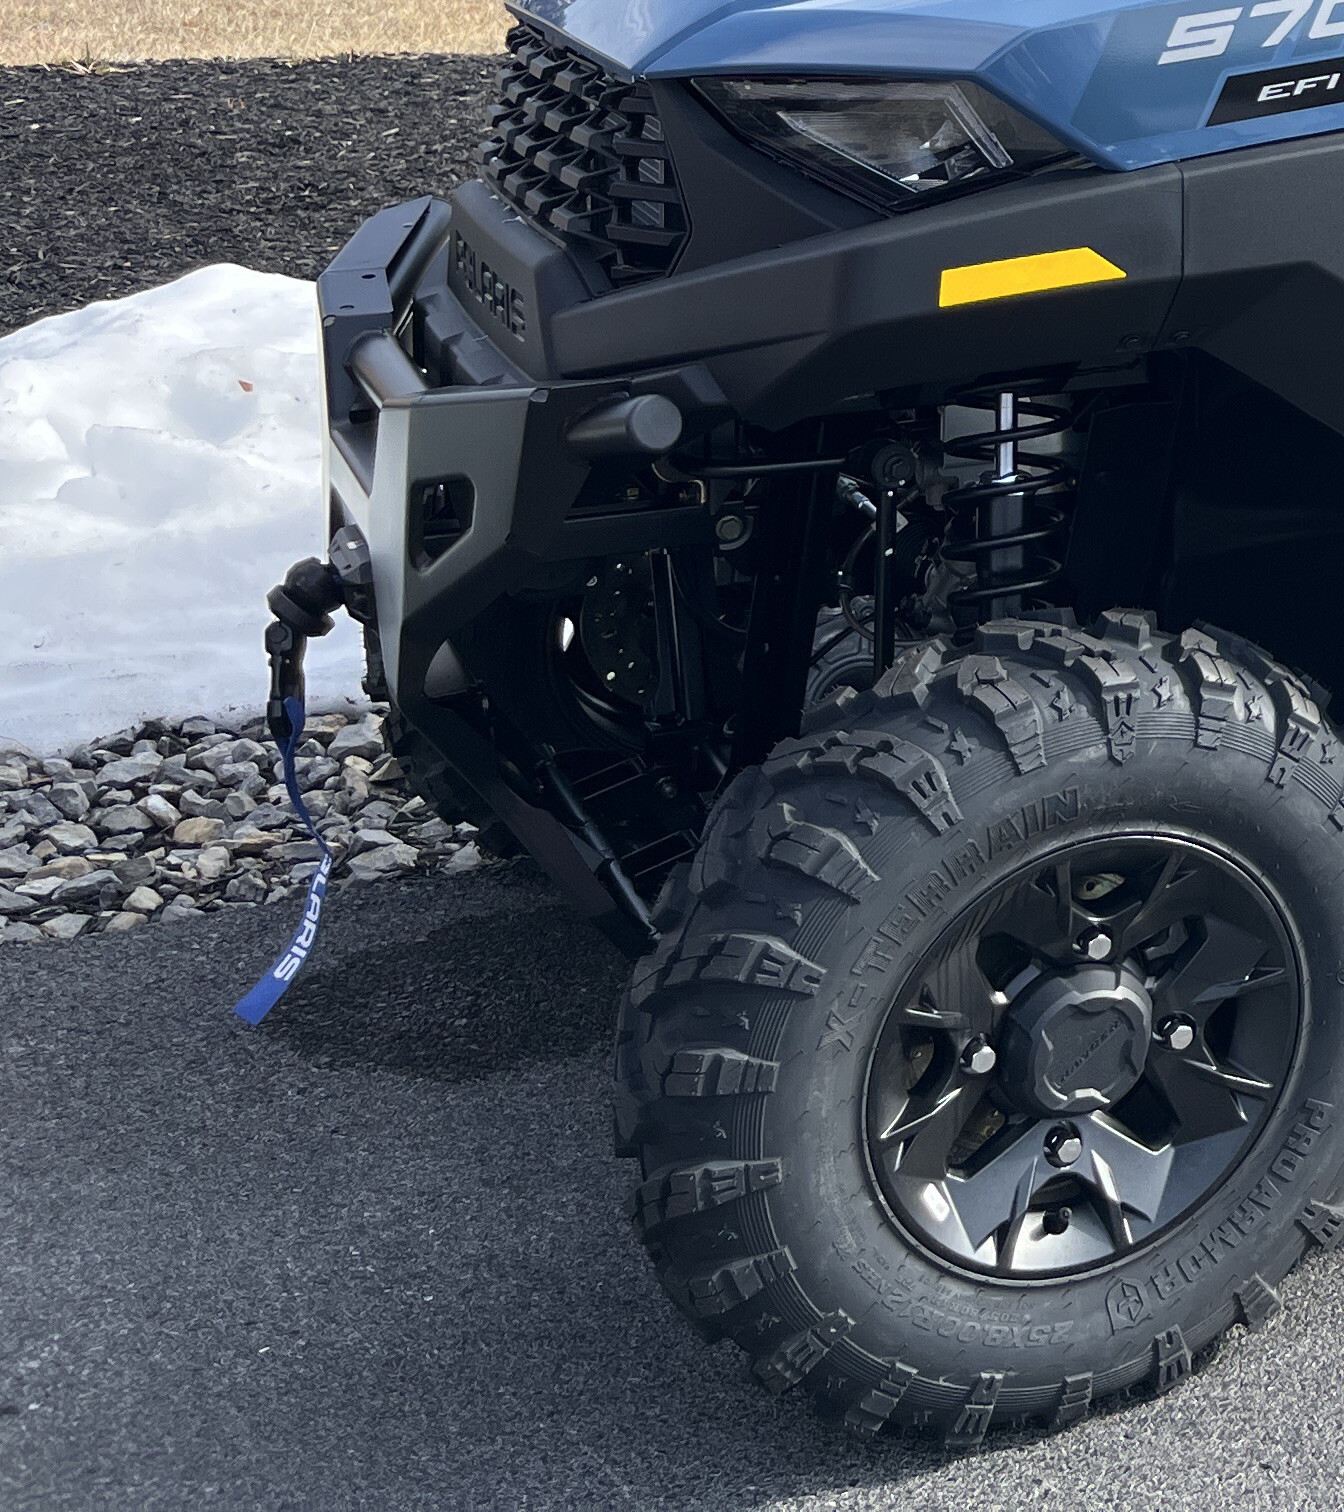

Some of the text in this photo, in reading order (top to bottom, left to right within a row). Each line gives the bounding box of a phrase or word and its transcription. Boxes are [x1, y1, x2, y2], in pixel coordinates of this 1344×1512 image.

[1257, 73, 1341, 102] EFI
[273, 853, 332, 982] OLARIS
[816, 785, 1081, 1052] X-TERRAIN
[1150, 1097, 1336, 1300] PRO ARMOR
